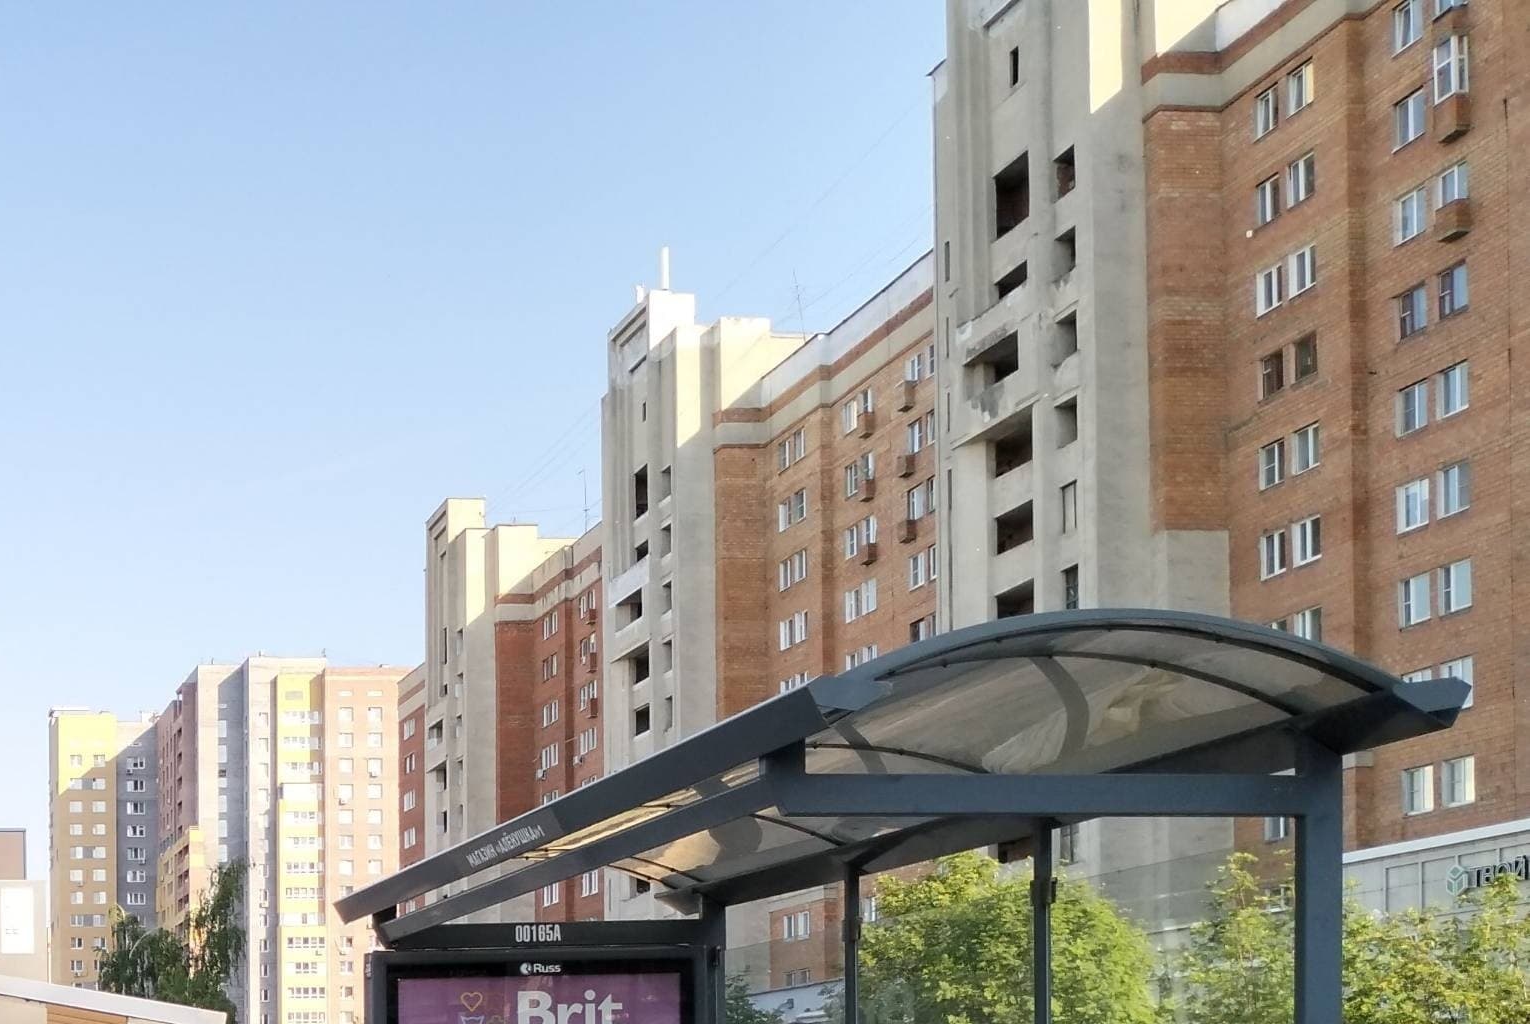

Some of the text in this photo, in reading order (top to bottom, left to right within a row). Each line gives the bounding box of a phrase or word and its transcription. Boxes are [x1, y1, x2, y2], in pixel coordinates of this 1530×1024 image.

[466, 843, 498, 868] МАГАЗИН
[515, 924, 561, 942] 00165A
[533, 963, 562, 974] Russ
